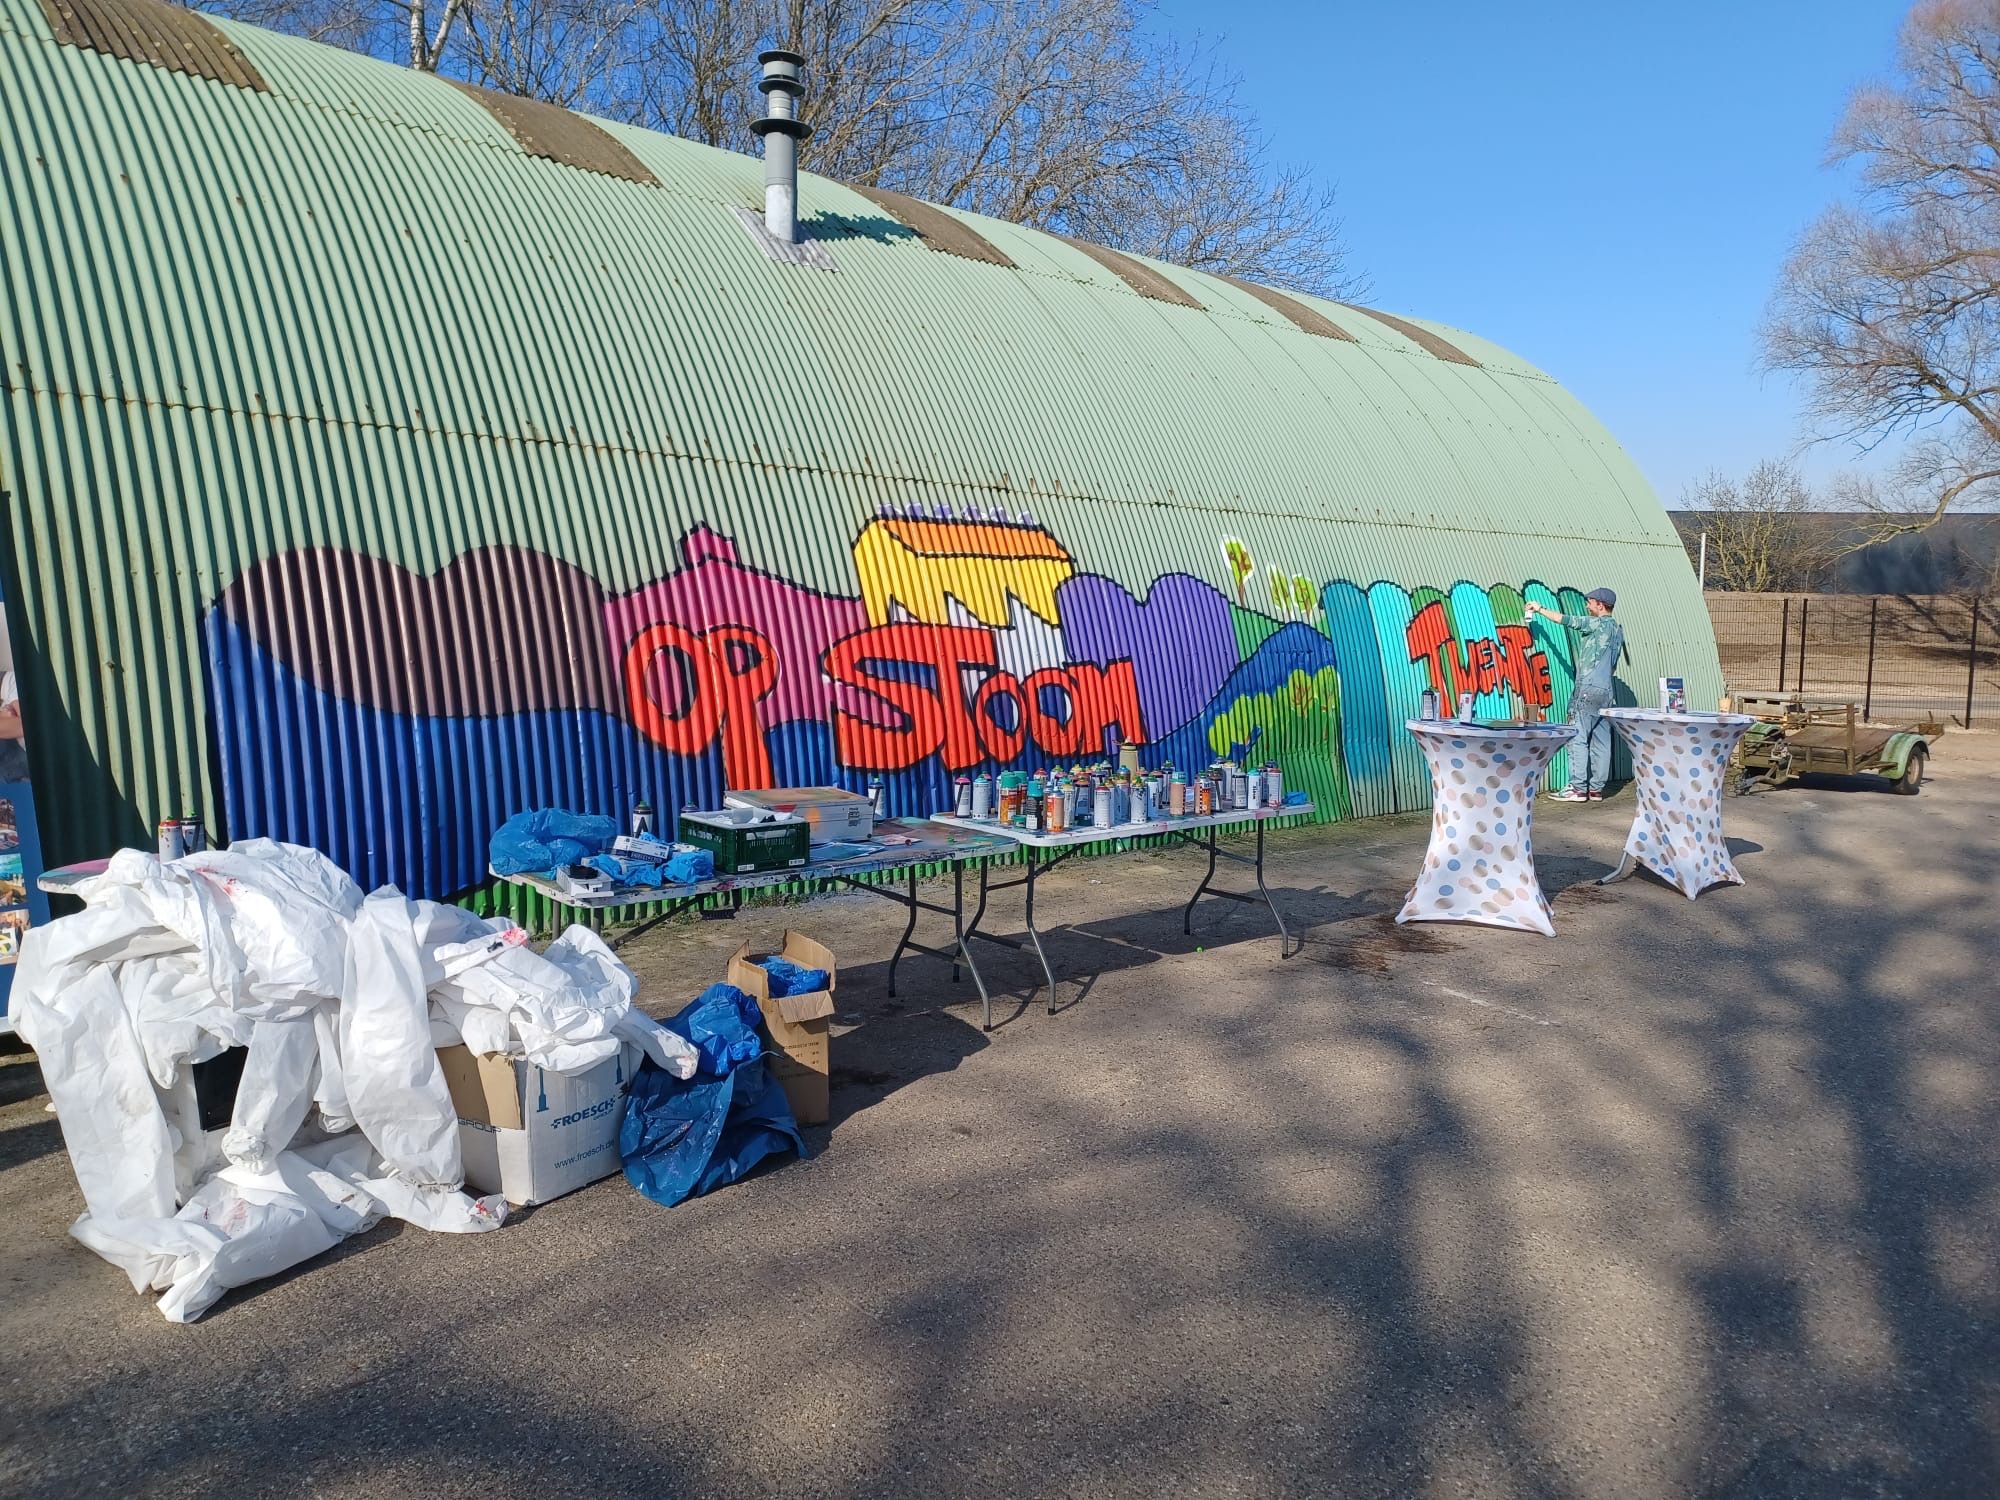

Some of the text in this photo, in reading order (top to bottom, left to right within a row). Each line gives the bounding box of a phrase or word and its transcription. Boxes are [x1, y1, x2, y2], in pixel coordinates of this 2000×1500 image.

[622, 620, 780, 790] OP
[1406, 600, 1553, 718] TWENTE
[551, 1096, 615, 1129] FROESCH
